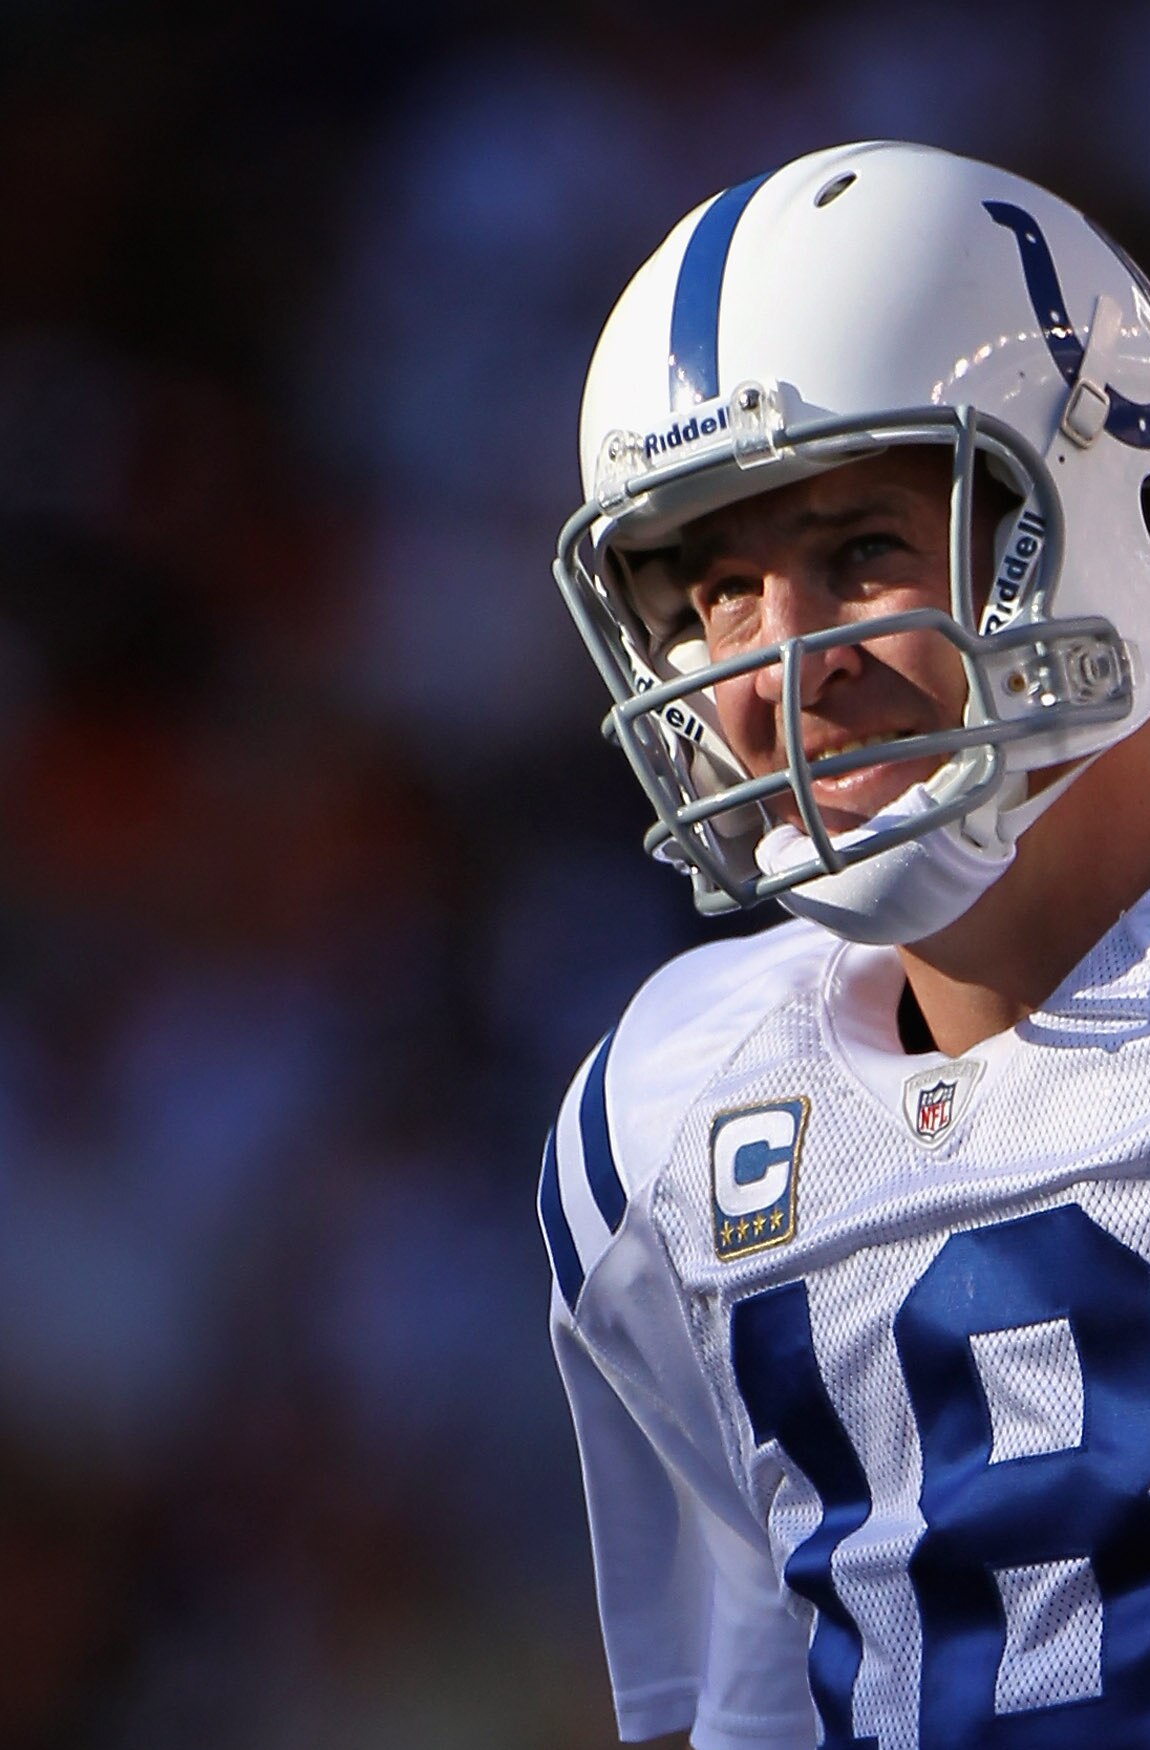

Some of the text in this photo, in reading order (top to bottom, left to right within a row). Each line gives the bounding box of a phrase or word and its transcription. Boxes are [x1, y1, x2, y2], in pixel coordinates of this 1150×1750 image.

[985, 511, 1047, 634] Riddell
[714, 1110, 795, 1217] C
[920, 1102, 949, 1131] NFL
